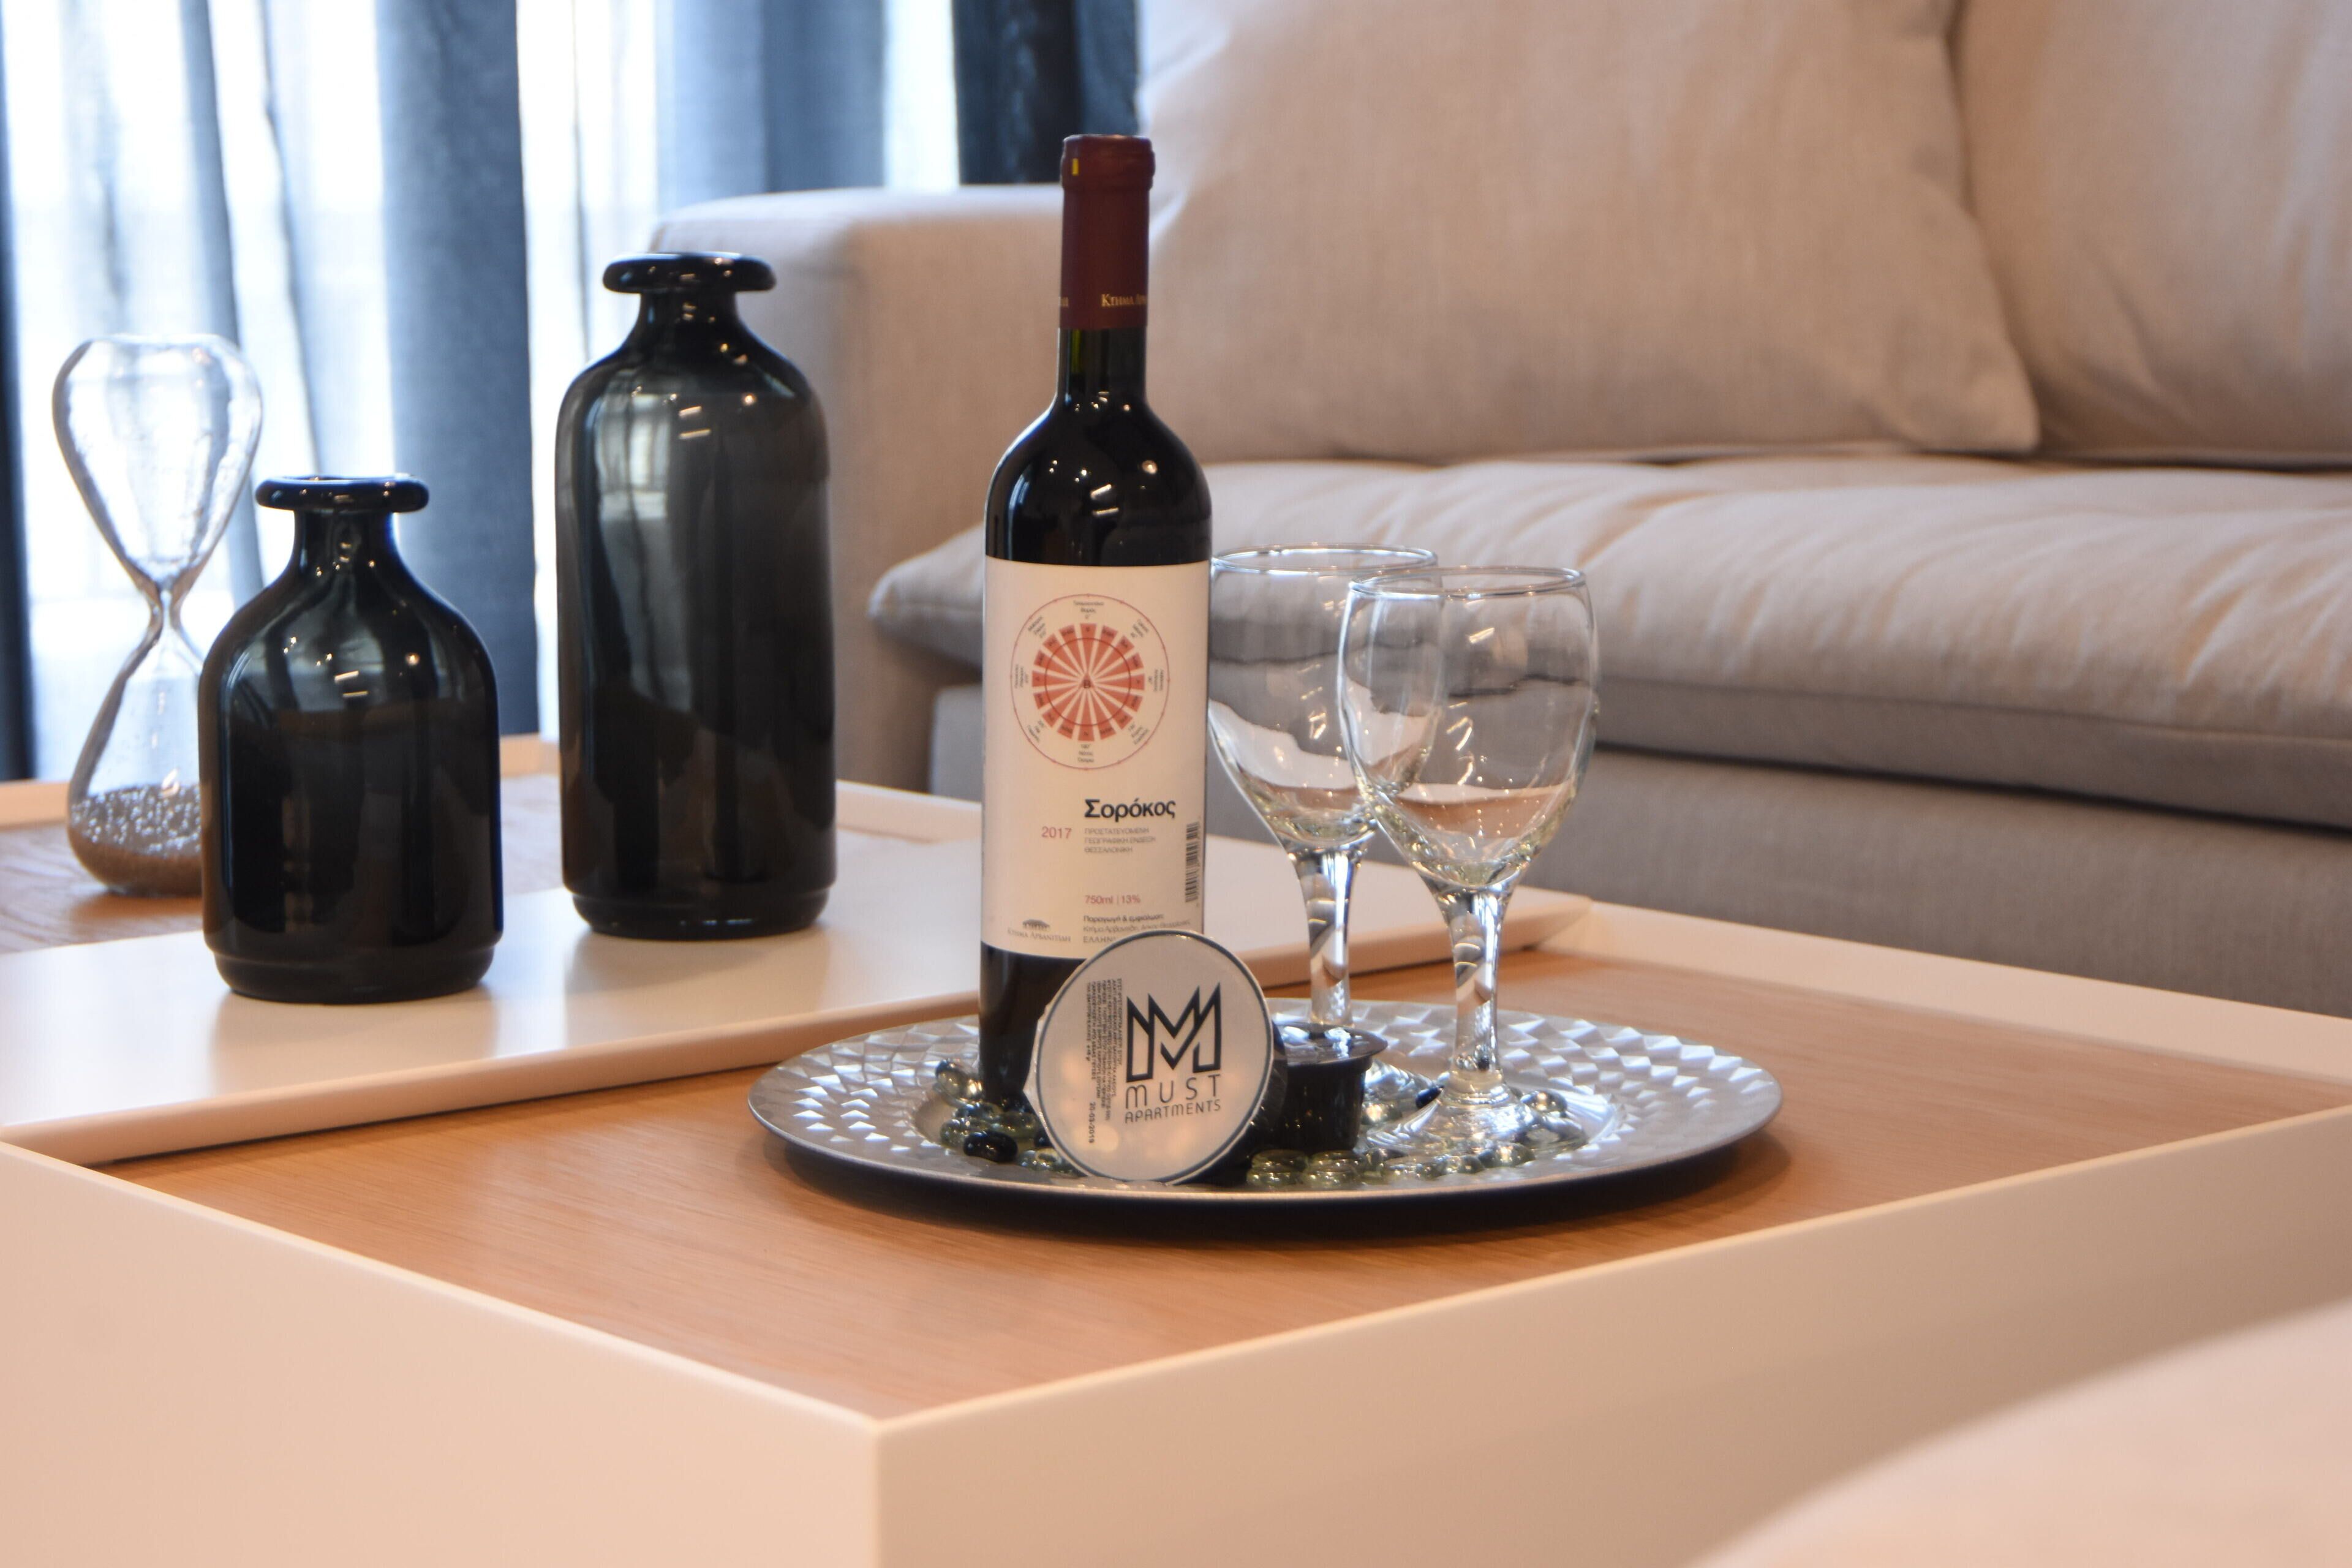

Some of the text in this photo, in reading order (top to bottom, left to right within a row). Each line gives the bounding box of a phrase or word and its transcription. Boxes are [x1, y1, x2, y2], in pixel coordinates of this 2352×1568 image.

[1084, 798, 1176, 822] Σορόκος
[1041, 826, 1072, 839] 2017
[1085, 894, 1113, 904] 750ml
[1125, 1074, 1221, 1109] MUST
[1125, 1099, 1221, 1124] APARTMENTS
